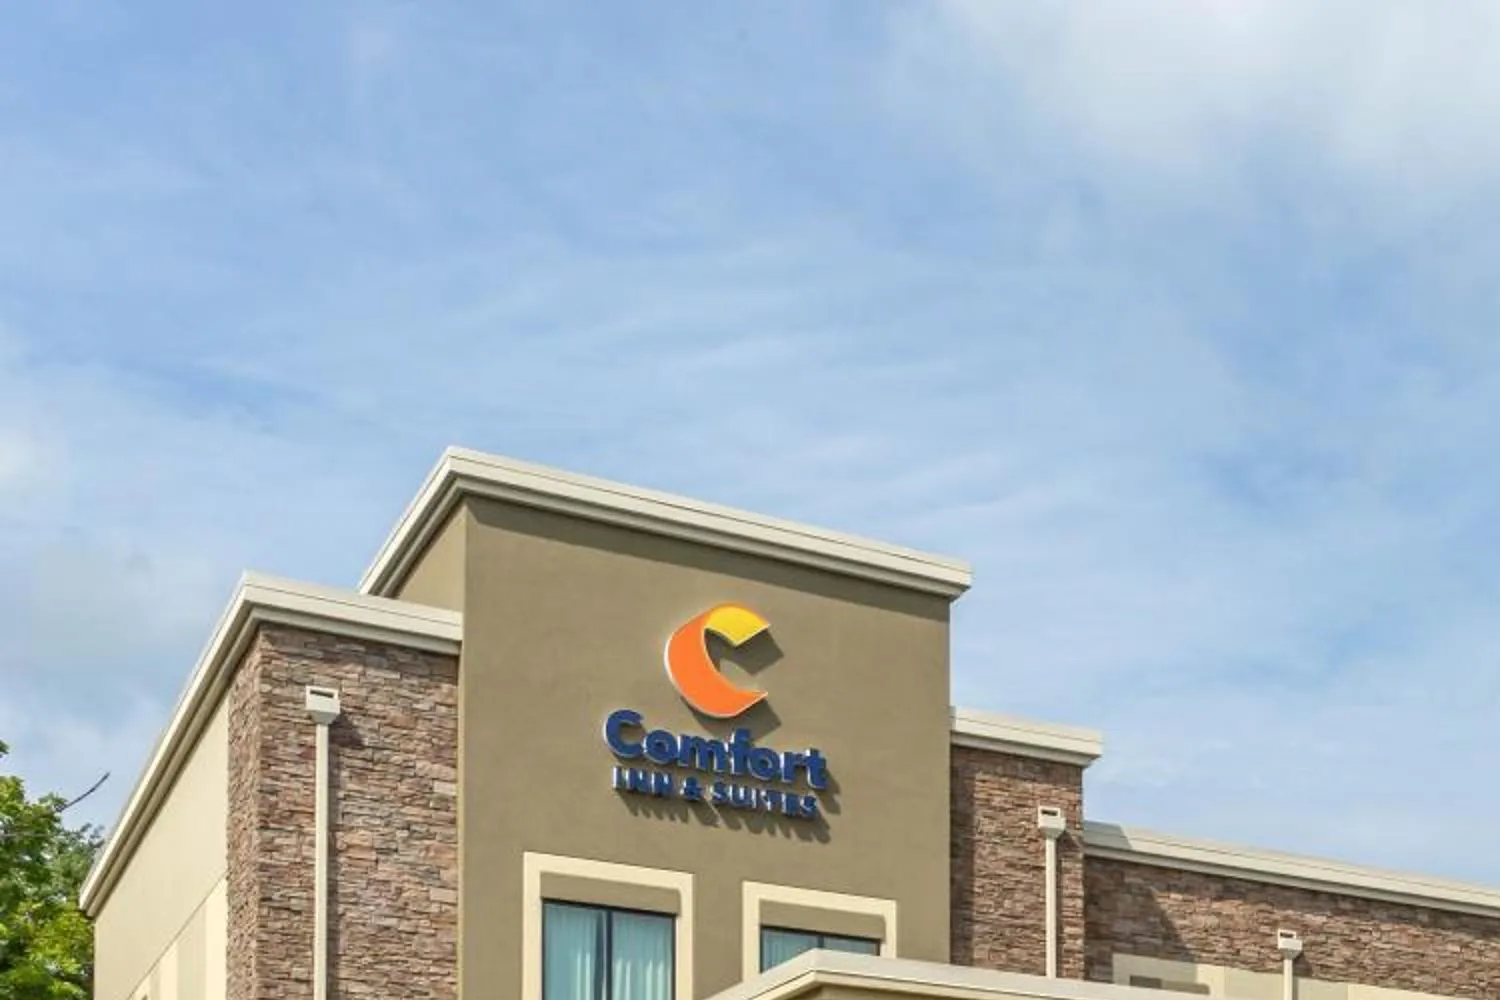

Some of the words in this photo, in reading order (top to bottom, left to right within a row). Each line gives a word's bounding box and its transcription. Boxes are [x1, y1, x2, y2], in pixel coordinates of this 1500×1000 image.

[603, 708, 827, 789] Comfort
[612, 765, 674, 796] INN
[679, 776, 703, 801] &
[710, 781, 817, 819] SUITES
